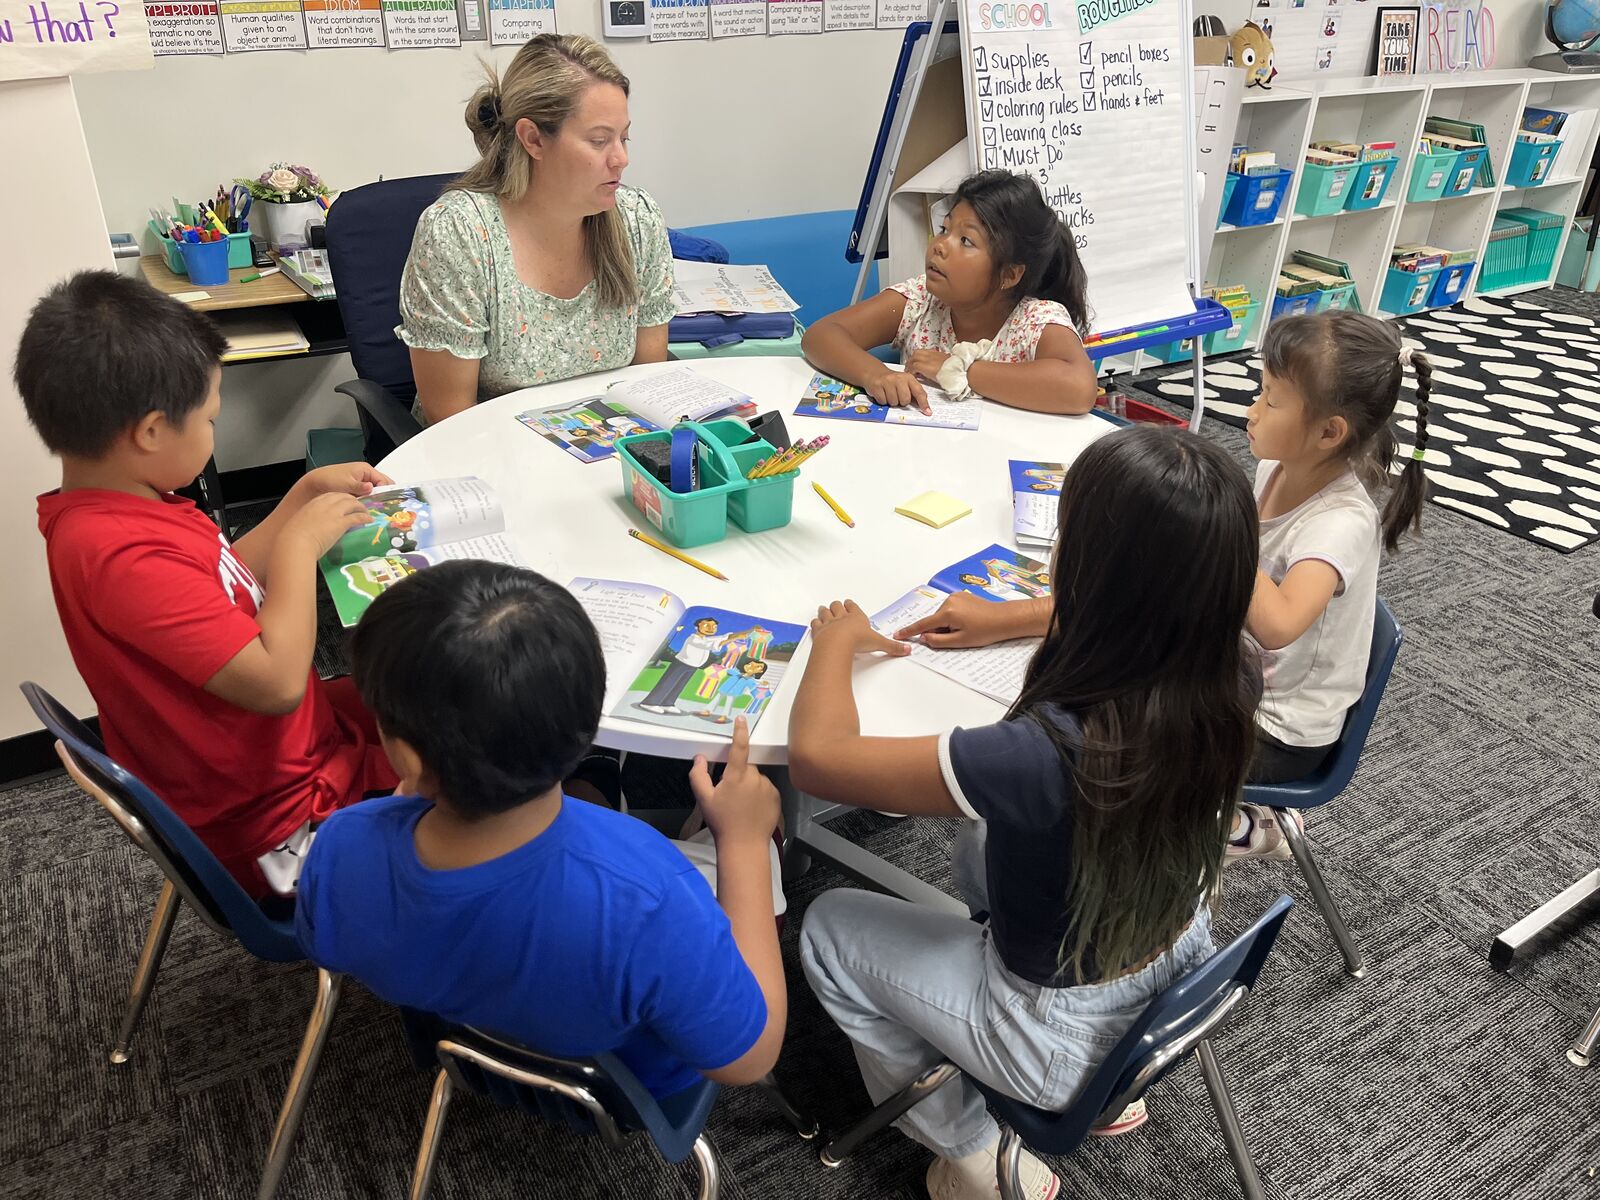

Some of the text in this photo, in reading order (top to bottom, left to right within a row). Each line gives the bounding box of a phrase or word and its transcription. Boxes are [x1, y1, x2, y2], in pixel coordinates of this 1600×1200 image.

[144, 4, 217, 16] YPERBOLE
[323, 0, 360, 12] IDIOM
[770, 5, 821, 14] Comparing things
[893, 4, 909, 13] object
[231, 13, 295, 24] Human qualities
[307, 15, 380, 24] Word combinations
[394, 16, 416, 24] Words
[433, 15, 448, 23] start
[656, 12, 676, 20] phrase
[677, 10, 685, 18] of
[979, 3, 1052, 30] SCHOOL
[26, 1, 119, 42] that?
[152, 17, 204, 28] exaggeration
[502, 18, 542, 29] Comparing
[670, 20, 689, 28] words
[723, 17, 739, 25] sound
[771, 18, 786, 26] using
[242, 26, 264, 36] given
[317, 25, 374, 34] that don't have
[437, 25, 457, 33] sound
[653, 30, 706, 39] opposite meanings
[740, 26, 756, 34] object
[1386, 22, 1411, 37] TAKE
[236, 36, 258, 46] object
[271, 35, 296, 43] animal
[317, 36, 377, 46] literal meanings
[433, 36, 455, 45] phrase
[494, 32, 507, 40] two
[508, 31, 530, 40] unlike
[1427, 7, 1496, 71] READ
[1383, 38, 1410, 55] YOUR
[991, 43, 1050, 77] supplies
[1101, 43, 1170, 69] pencil boxes
[1383, 56, 1408, 72] TIME
[995, 68, 1064, 97] inside desk
[1103, 64, 1142, 95] pencils
[1100, 92, 1131, 110] hands
[1143, 88, 1165, 107] feet
[996, 93, 1079, 123] coloring rules
[1000, 120, 1082, 147] leaving class
[1044, 184, 1082, 208] bottles
